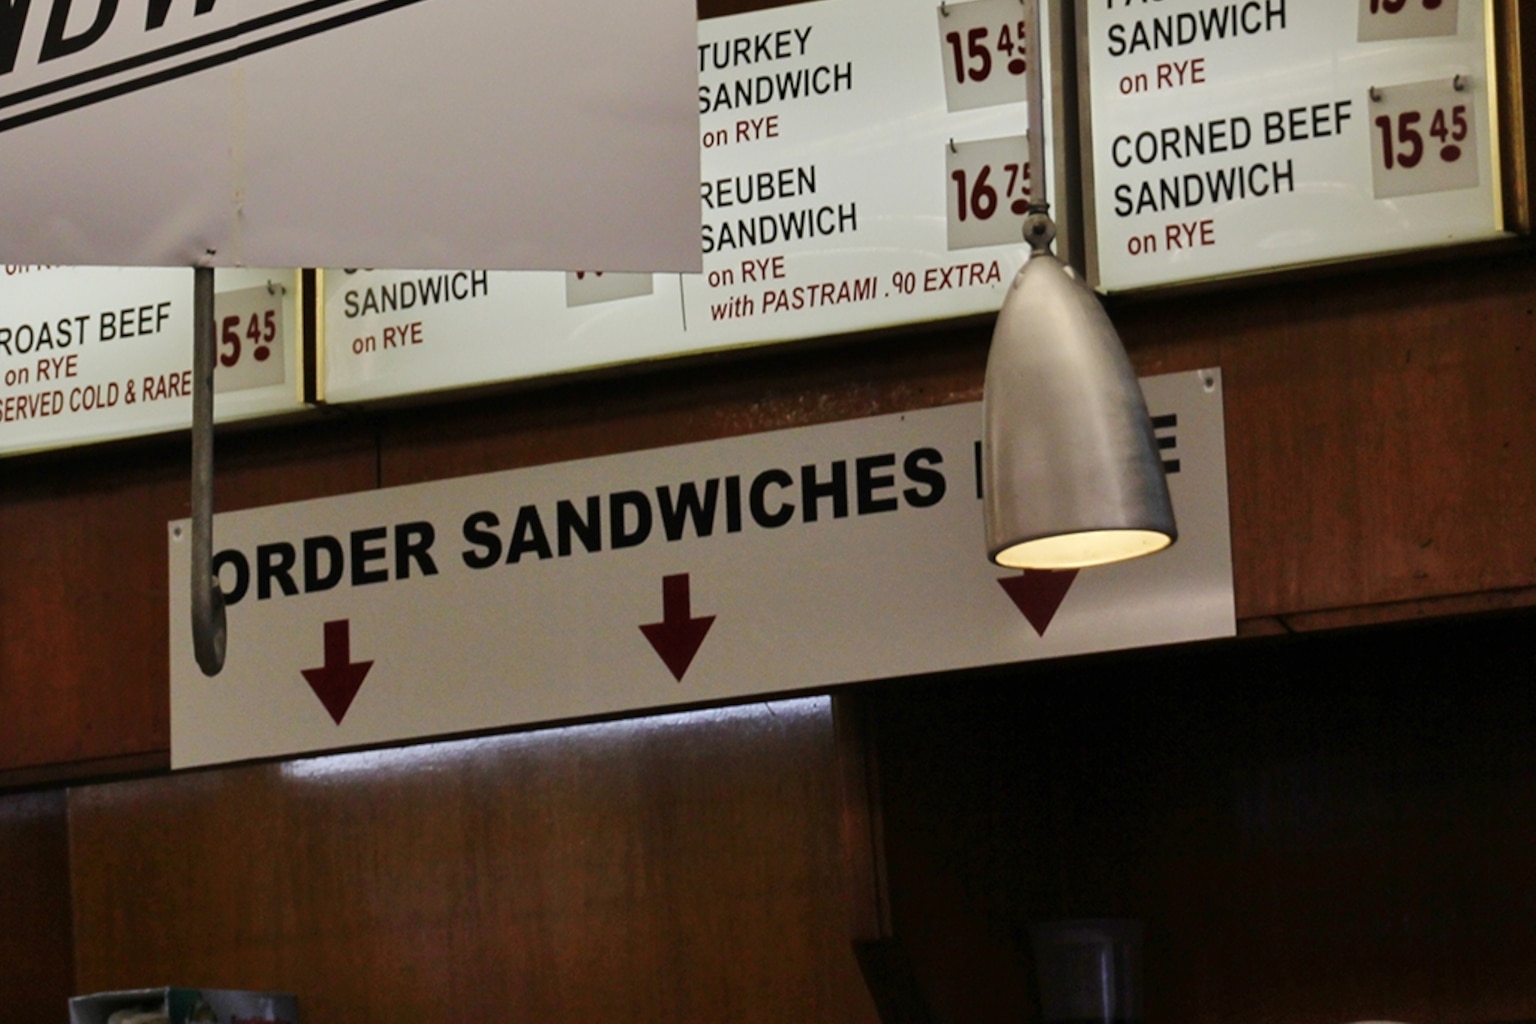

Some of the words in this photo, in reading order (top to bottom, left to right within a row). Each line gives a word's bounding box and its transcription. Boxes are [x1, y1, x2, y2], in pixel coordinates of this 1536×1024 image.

[698, 26, 813, 72] TURKEY
[699, 61, 853, 114] SANDWICH
[1119, 69, 1148, 94] on
[1157, 58, 1206, 90] RYE
[702, 124, 728, 148] on
[736, 115, 779, 143] RYE
[1112, 117, 1251, 168] CORNED
[1264, 100, 1352, 145] BEEF
[700, 165, 817, 209] REUBEN
[1114, 159, 1295, 217] SANDWICH
[702, 202, 857, 253] SANDWICH
[1128, 230, 1157, 256] on
[1165, 219, 1215, 251] RYE
[344, 270, 489, 318] SANDWICH
[708, 265, 734, 288] on
[742, 256, 786, 283] RYE
[711, 293, 754, 321] with
[763, 276, 877, 314] PASTRAMI
[884, 272, 916, 298] .90
[923, 260, 1002, 292] EXTRA
[98, 302, 171, 342] BEEF
[352, 332, 376, 355] on
[383, 322, 424, 350] RYE
[5, 365, 29, 387] on
[37, 354, 78, 381] RYE
[69, 382, 119, 412] COLD
[124, 380, 136, 404] &
[142, 370, 192, 402] RARE
[212, 521, 439, 607] ORDER
[461, 447, 947, 569] SANDWICHES
